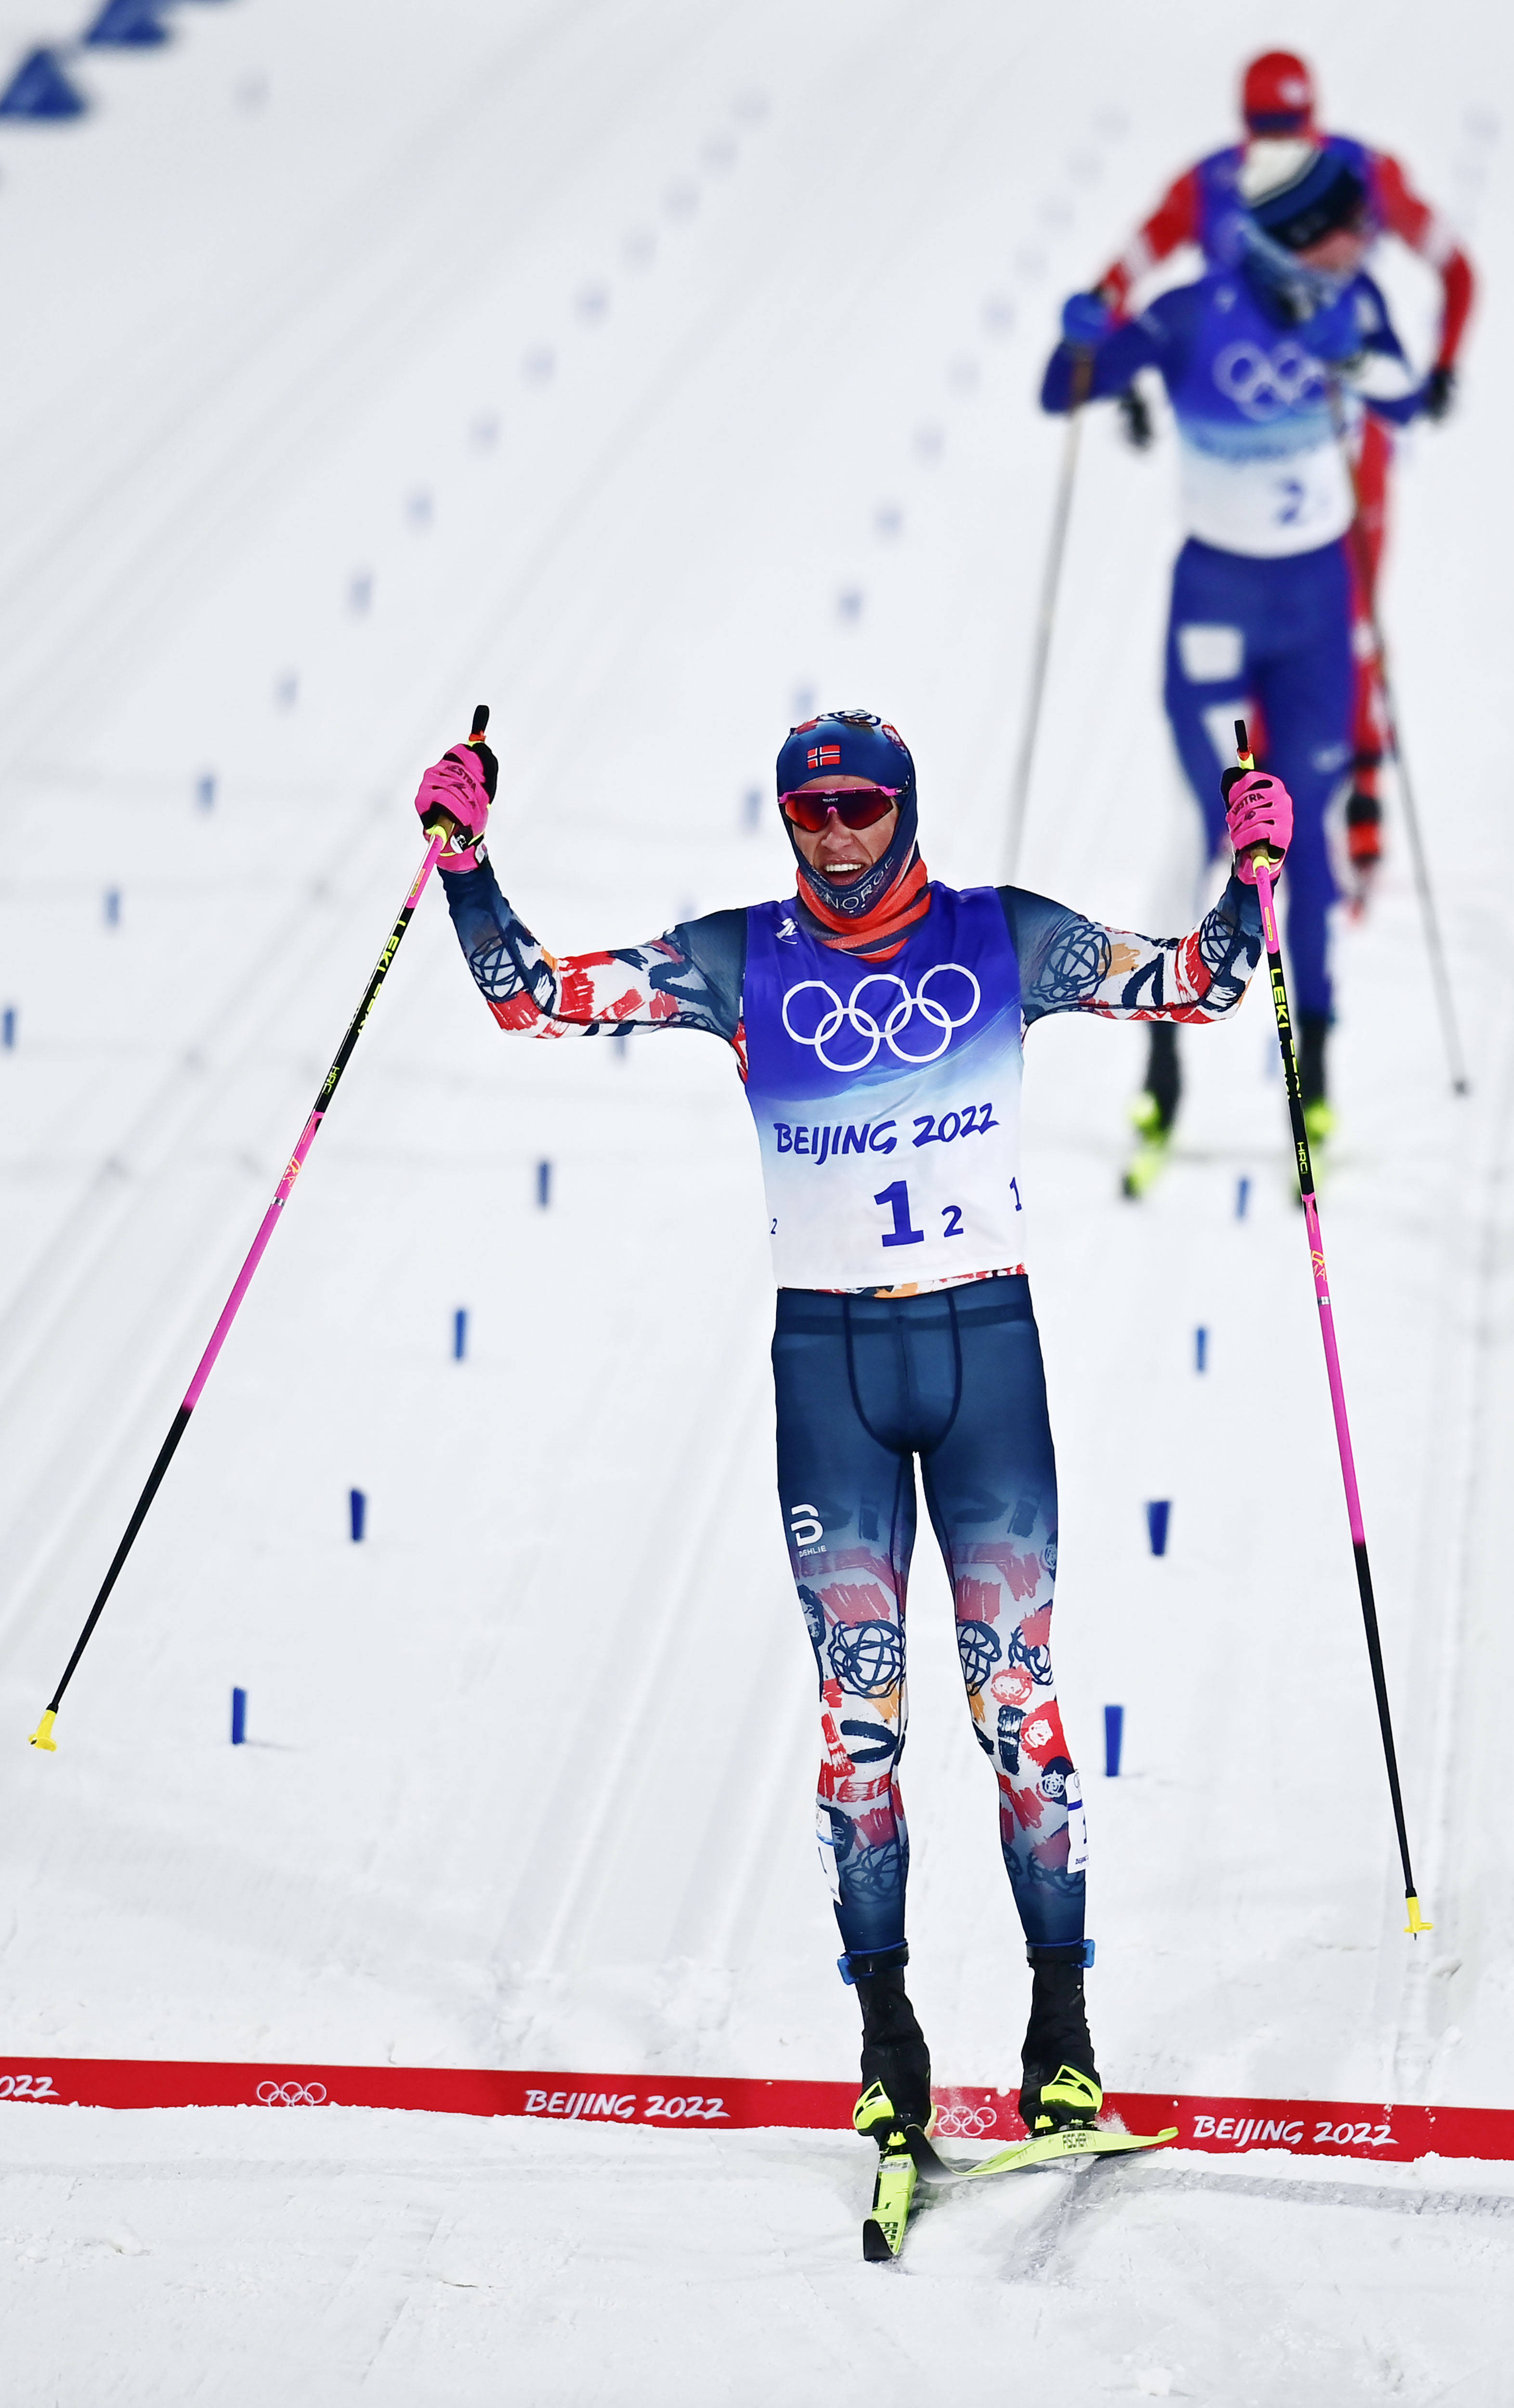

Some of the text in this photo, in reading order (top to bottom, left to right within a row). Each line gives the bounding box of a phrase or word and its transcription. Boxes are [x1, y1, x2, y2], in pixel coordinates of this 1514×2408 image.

[1270, 968, 1290, 1028] LEKI
[322, 1065, 340, 1093] HRC
[773, 1102, 1001, 1165] BEIJING 2022
[1297, 1141, 1308, 1172] HRC
[1009, 1177, 1022, 1211] 1
[770, 1218, 778, 1235] 2
[874, 1180, 964, 1247] 1 2
[524, 2089, 731, 2120] BEIJING 2022
[1193, 2115, 1399, 2147] BEIJING 2022
